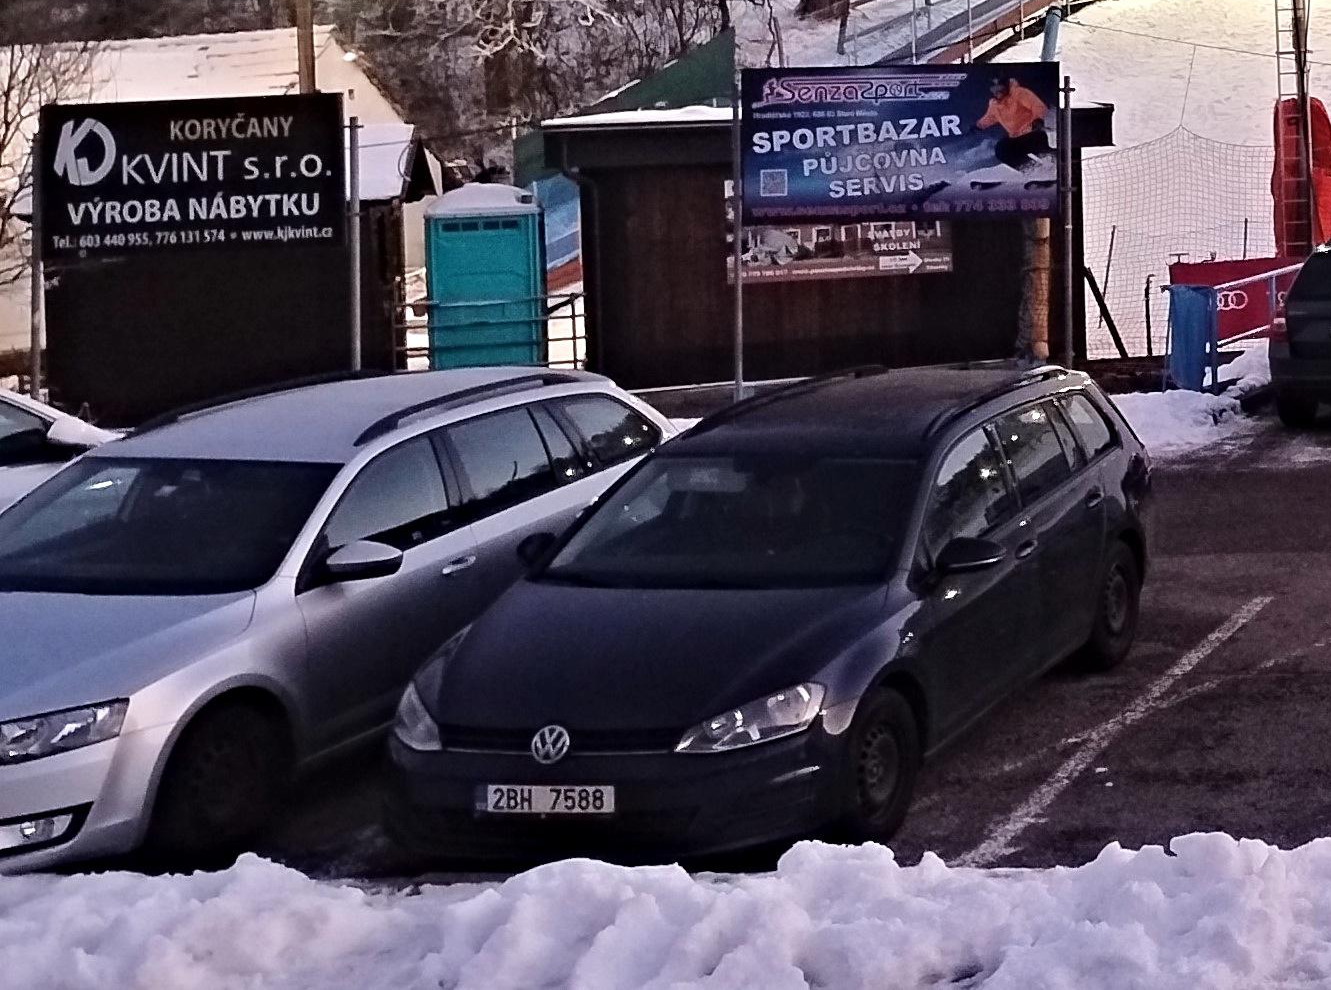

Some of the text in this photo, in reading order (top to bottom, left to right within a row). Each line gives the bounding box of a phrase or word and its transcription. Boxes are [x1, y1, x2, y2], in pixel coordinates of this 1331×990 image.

[170, 113, 294, 141] KORYČANY
[752, 114, 962, 154] SPORTBAZAR
[122, 150, 332, 185] KVINT s.r.o.
[829, 173, 924, 198] SERVIS
[67, 191, 320, 226] VÝROBA NÁBYTKU
[79, 234, 100, 248] 603
[103, 233, 125, 247] 440
[155, 231, 177, 245] 776
[180, 230, 200, 243] 131
[203, 229, 225, 243] 574
[241, 226, 333, 242] www.kjkvint.cz
[492, 788, 532, 810] 2BH
[549, 788, 604, 811] 7588
